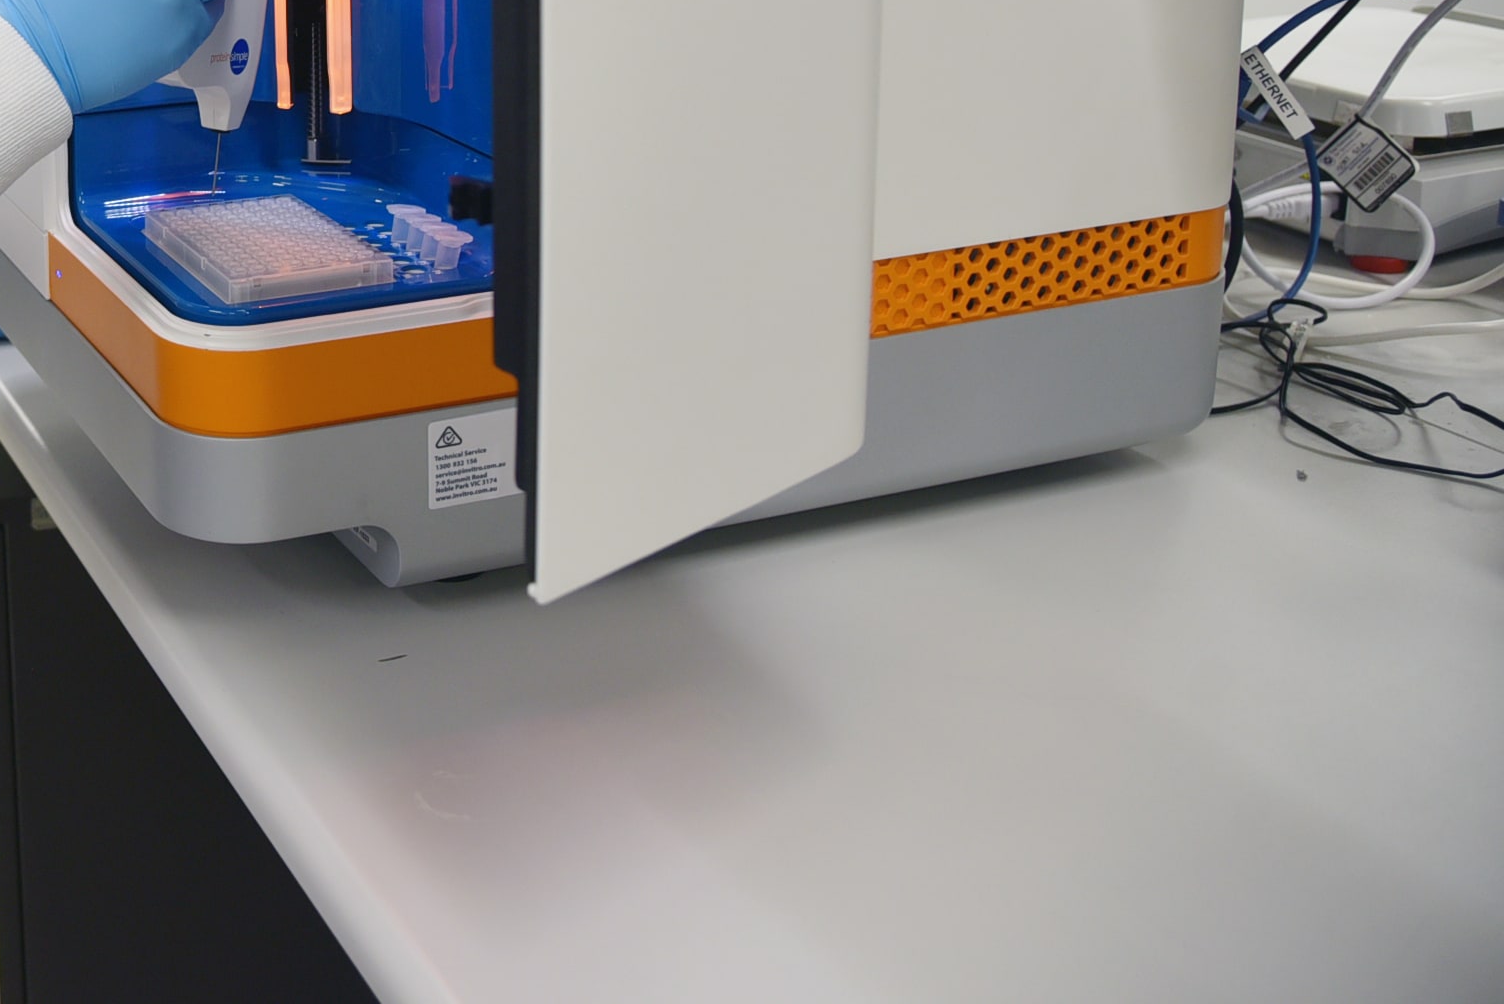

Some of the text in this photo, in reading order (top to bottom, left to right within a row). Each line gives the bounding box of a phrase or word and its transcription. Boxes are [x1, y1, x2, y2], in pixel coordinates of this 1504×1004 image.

[1244, 54, 1299, 118] ETHERNET
[435, 448, 487, 462] Technical Service
[435, 462, 506, 479] service@invitro.com.au
[436, 462, 451, 470] 1300
[447, 476, 470, 485] Summit
[472, 472, 488, 480] Road
[435, 485, 453, 494] Noble
[456, 481, 469, 490] Park
[436, 486, 497, 501] www.invitro.com.au
